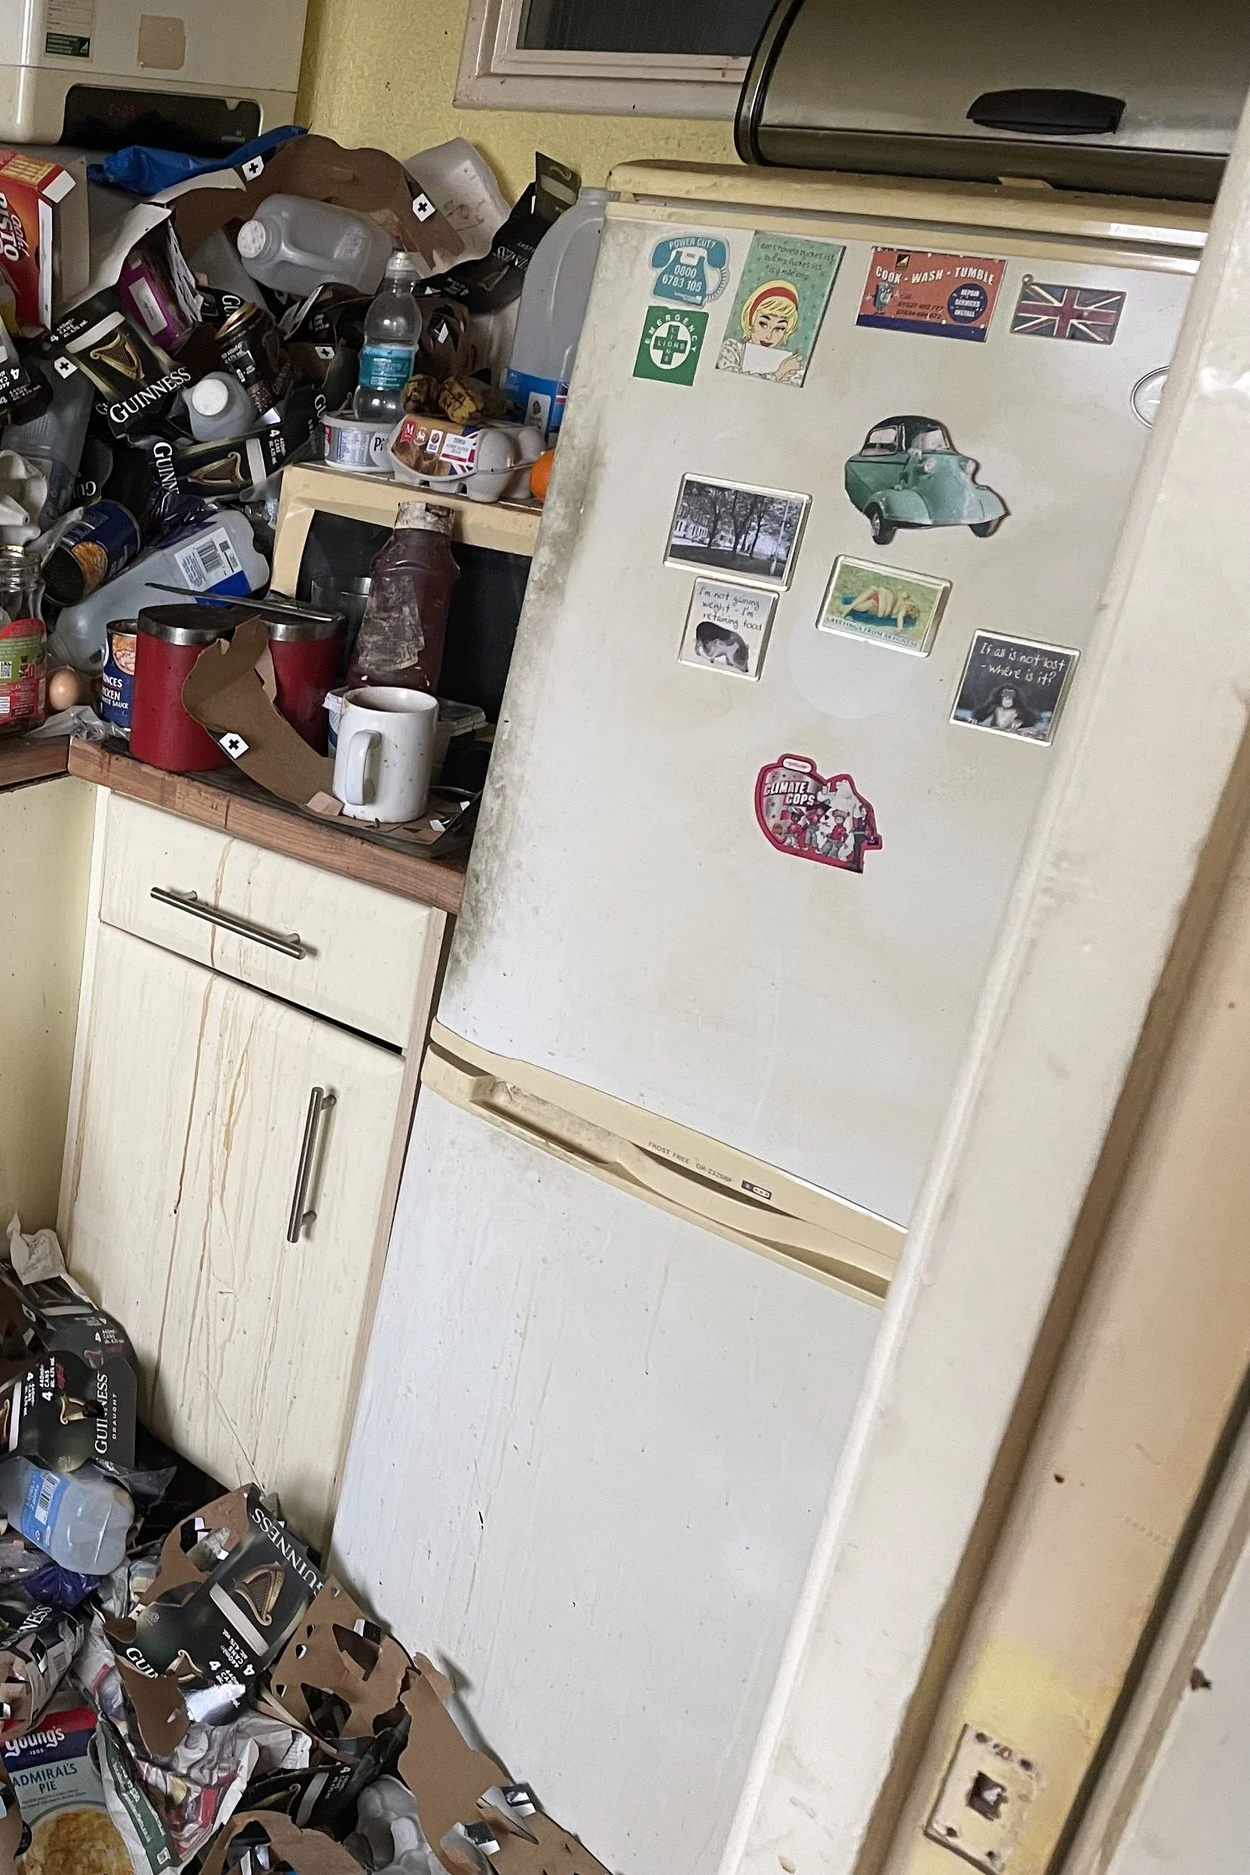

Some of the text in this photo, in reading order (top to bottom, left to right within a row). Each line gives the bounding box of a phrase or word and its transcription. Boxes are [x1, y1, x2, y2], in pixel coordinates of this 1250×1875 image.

[669, 238, 716, 250] POWER CUT?
[674, 264, 697, 279] 0800
[875, 266, 995, 285] COOK WASH TUMBLE
[662, 274, 702, 292] 6783 105
[50, 334, 59, 342] 4
[644, 314, 698, 352] EMERGENCY
[657, 340, 685, 350] LIONS
[10, 368, 19, 380] 4
[0, 396, 8, 404] 4
[109, 367, 191, 423] GUINNESS
[269, 429, 280, 437] 4
[699, 586, 760, 611] I'm not gaining
[702, 601, 730, 614] weight
[742, 606, 754, 617] I'm
[703, 612, 762, 631] retaining food
[825, 616, 862, 631] GREETINGS
[863, 627, 883, 636] FROM
[980, 642, 993, 654] If
[1008, 648, 1017, 661] is
[1020, 655, 1041, 666] not
[1043, 658, 1065, 672] lost
[989, 664, 1021, 679] where
[1025, 668, 1034, 681] is
[1037, 671, 1056, 686] it?
[112, 700, 128, 709] SAUCE
[764, 781, 806, 796] CLIMATE
[785, 794, 816, 806] COPS
[648, 1141, 690, 1164] FROST FREE
[95, 1332, 101, 1342] 4
[42, 1391, 53, 1401] 4
[228, 1645, 243, 1665] CANS
[209, 1660, 221, 1671] 4
[243, 1664, 255, 1676] 4
[5, 1726, 65, 1758] young's
[12, 1763, 78, 1788] ADMIRAL'S
[39, 1780, 57, 1794] PIE
